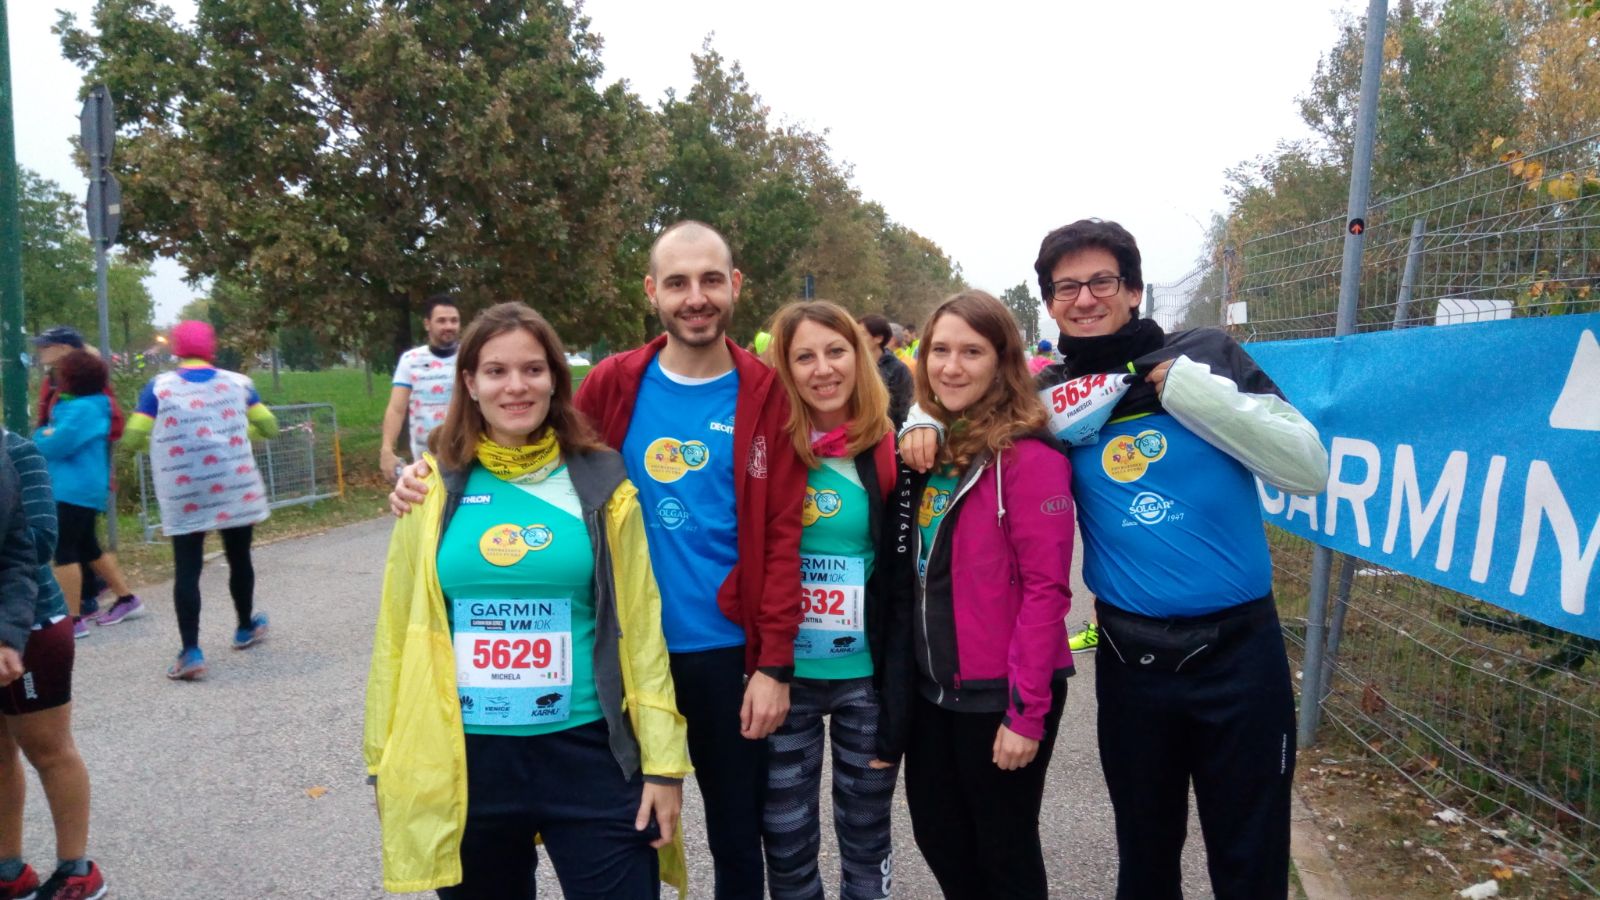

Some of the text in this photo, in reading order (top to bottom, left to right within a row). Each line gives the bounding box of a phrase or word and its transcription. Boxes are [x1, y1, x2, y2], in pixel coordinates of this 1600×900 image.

[1052, 373, 1107, 414] 5634
[1067, 400, 1093, 419] FRANCESCO
[462, 494, 491, 505] THLON
[1046, 498, 1068, 513] KIA
[1129, 501, 1170, 515] SOLGAR
[1167, 512, 1184, 522] 1947
[800, 557, 846, 571] RMIN
[810, 572, 828, 582] VM
[800, 588, 845, 616] 632
[470, 603, 552, 617] GARMIN
[510, 619, 533, 631] VM
[533, 619, 552, 631] 10K
[473, 638, 552, 670] 5629
[490, 673, 521, 681] MICHELA
